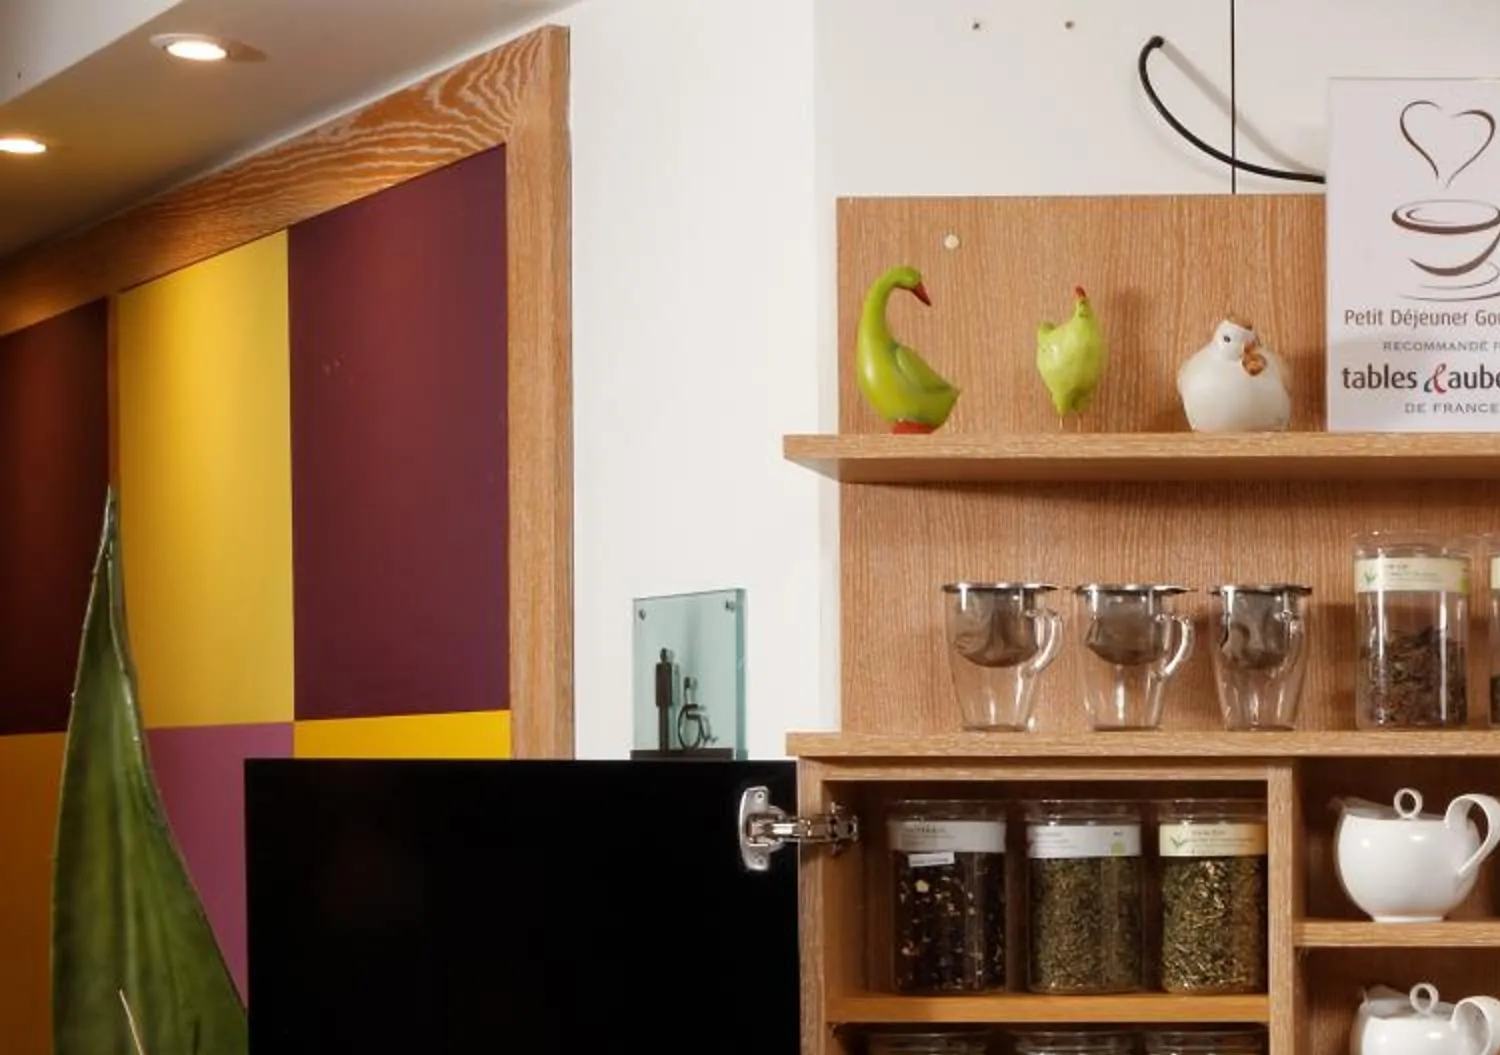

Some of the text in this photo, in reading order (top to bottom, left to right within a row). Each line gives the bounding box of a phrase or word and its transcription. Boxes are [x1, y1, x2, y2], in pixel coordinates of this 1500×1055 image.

[1344, 309, 1383, 326] Petit
[1391, 309, 1468, 329] Déjeuner
[1342, 364, 1417, 389] tables
[1404, 403, 1499, 414] DE FRANCE
